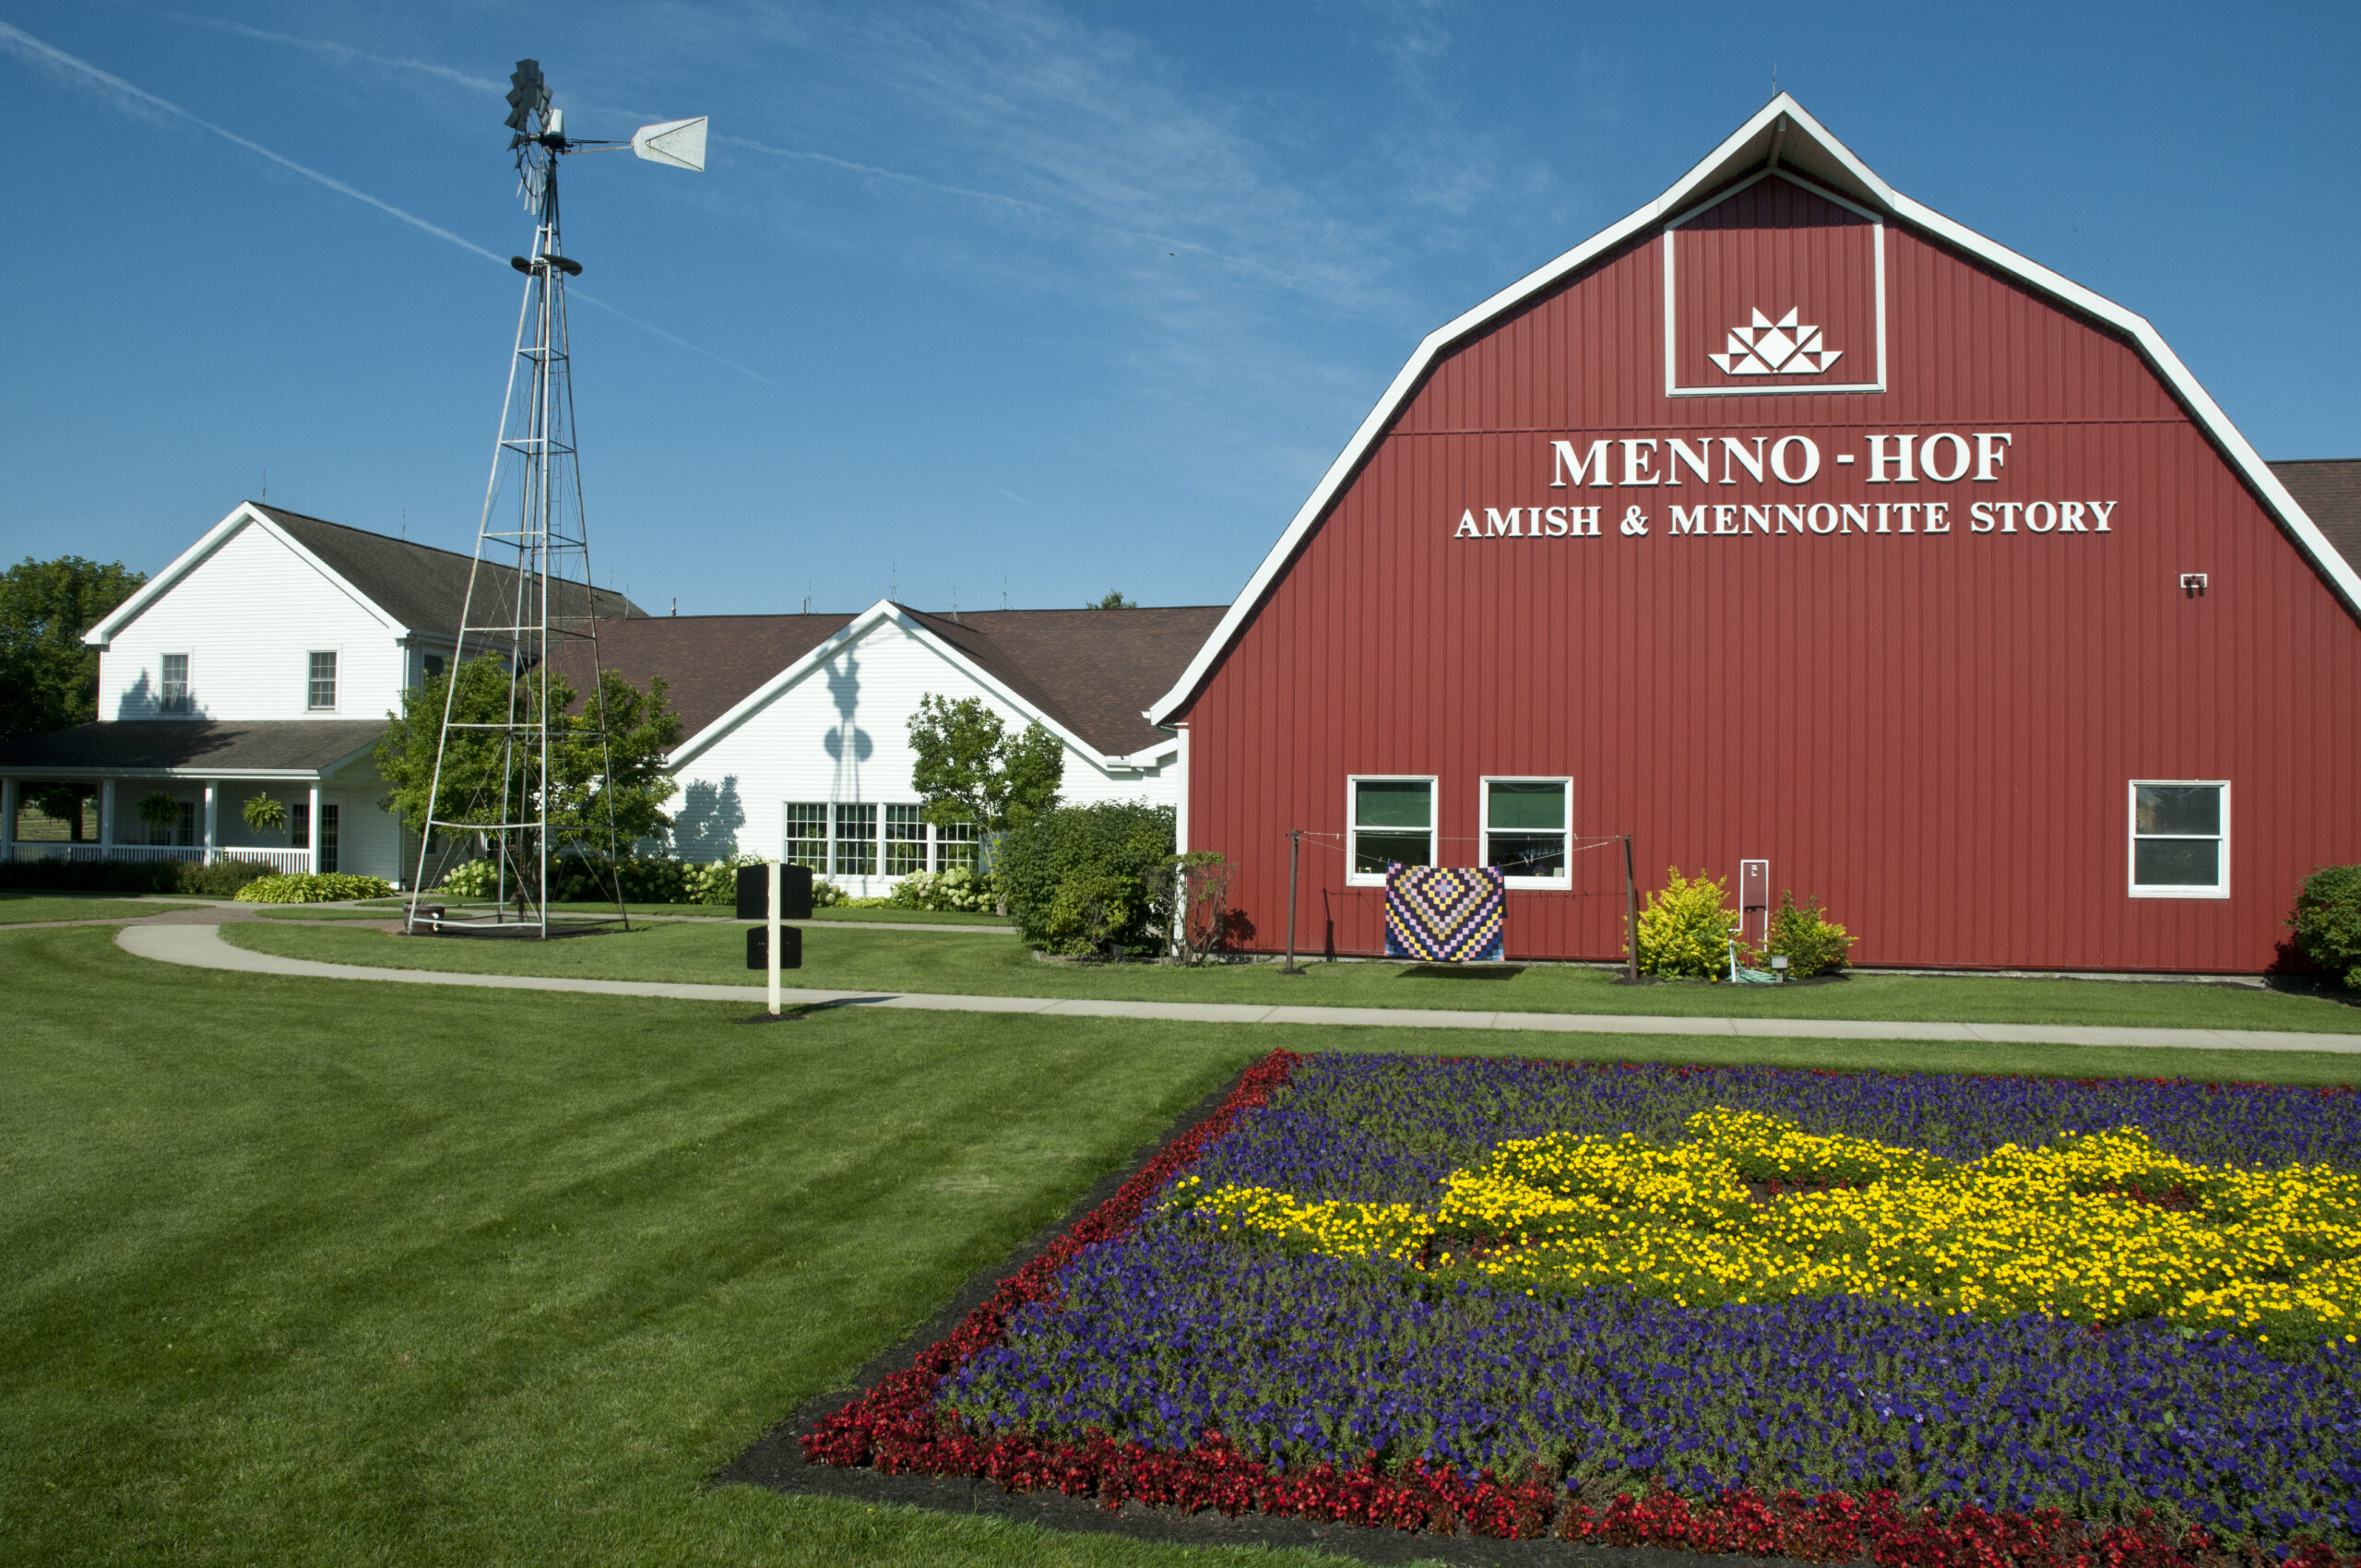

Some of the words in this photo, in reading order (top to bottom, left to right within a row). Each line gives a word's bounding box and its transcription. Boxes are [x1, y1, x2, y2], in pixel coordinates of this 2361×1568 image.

[1453, 505, 1602, 538] AMISH
[1619, 505, 1650, 536] &
[1668, 502, 1952, 535] MENNONITE
[1970, 500, 2118, 532] STORY
